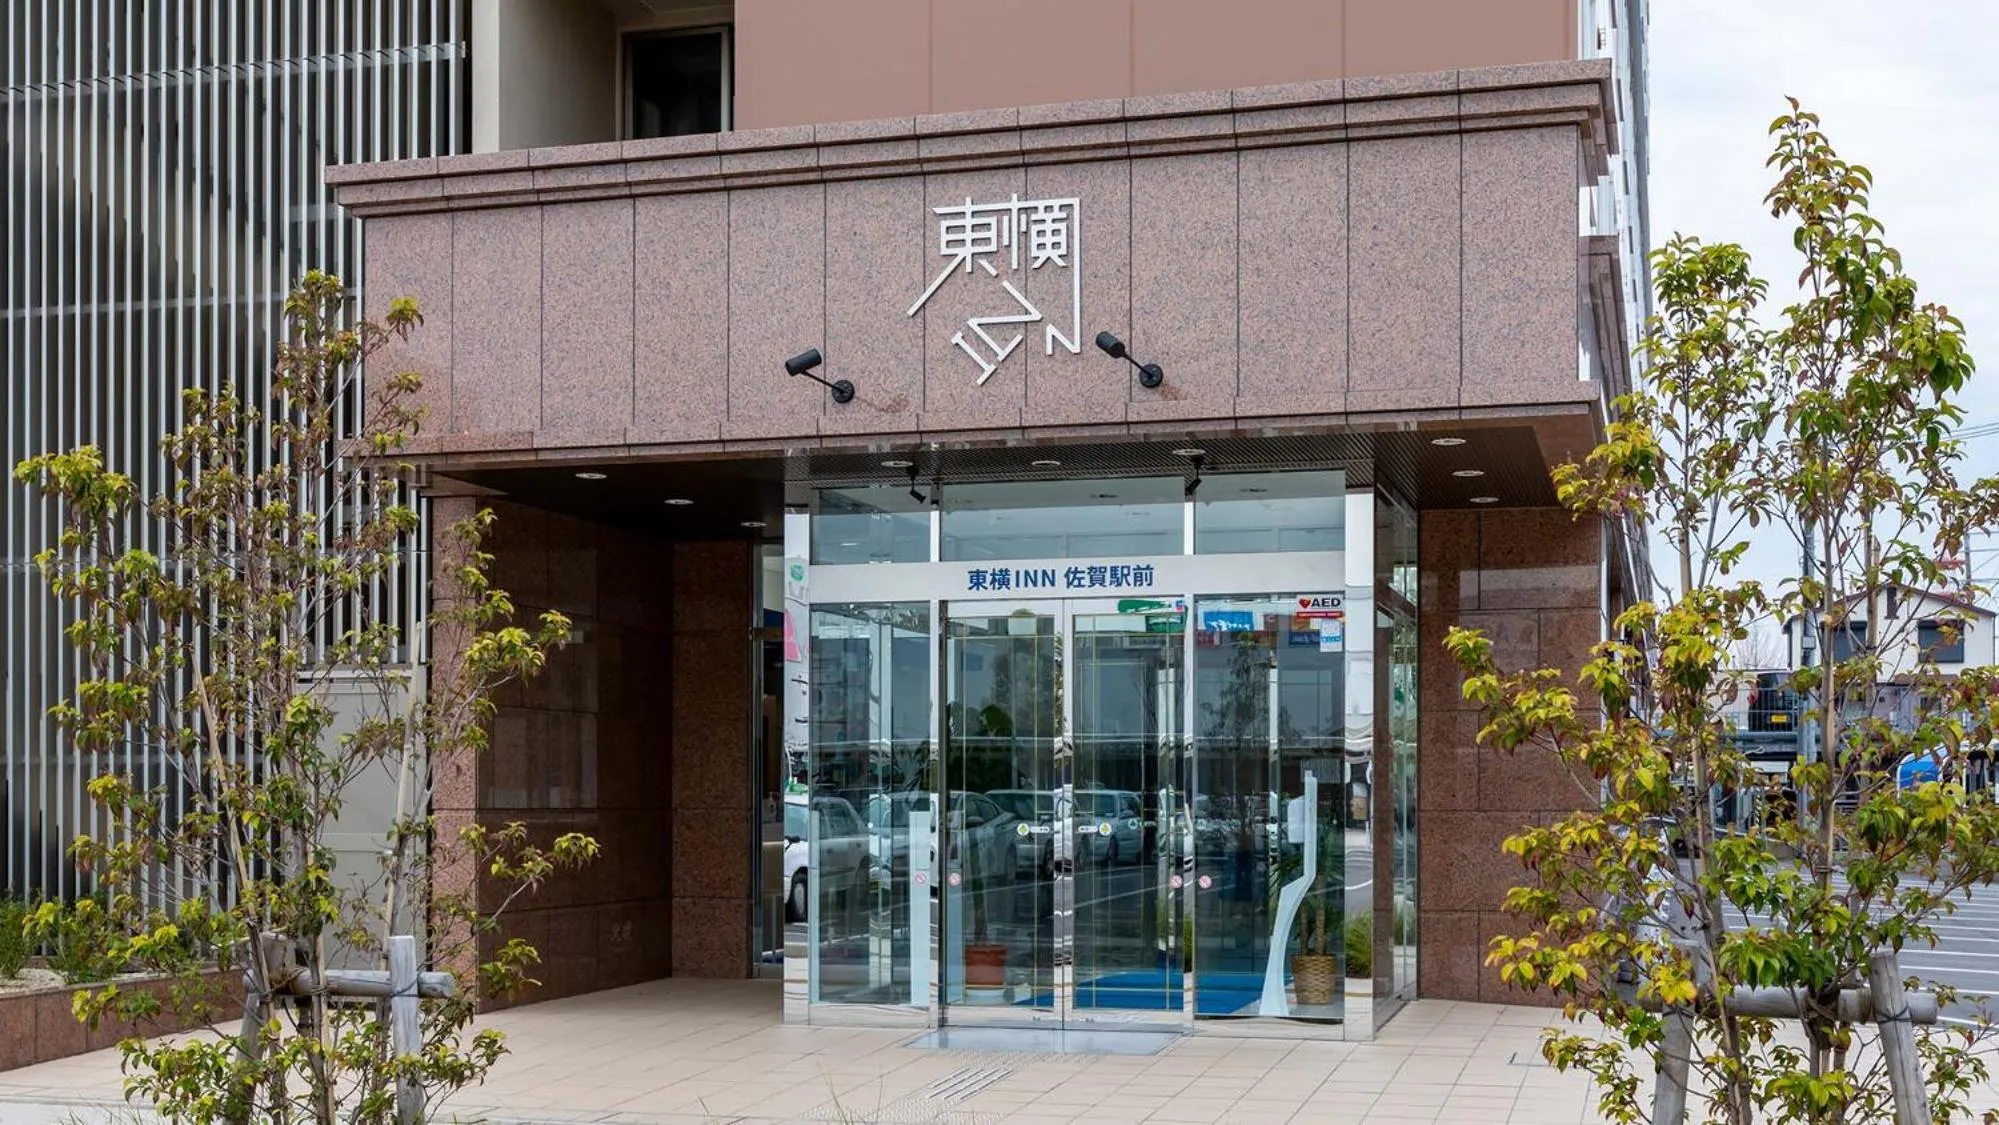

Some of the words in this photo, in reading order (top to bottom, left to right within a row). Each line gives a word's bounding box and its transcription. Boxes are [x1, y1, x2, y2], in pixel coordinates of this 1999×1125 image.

[968, 568, 1056, 591] 東横INN
[1064, 564, 1155, 589] 佐賀駅前
[1311, 597, 1342, 608] AED
